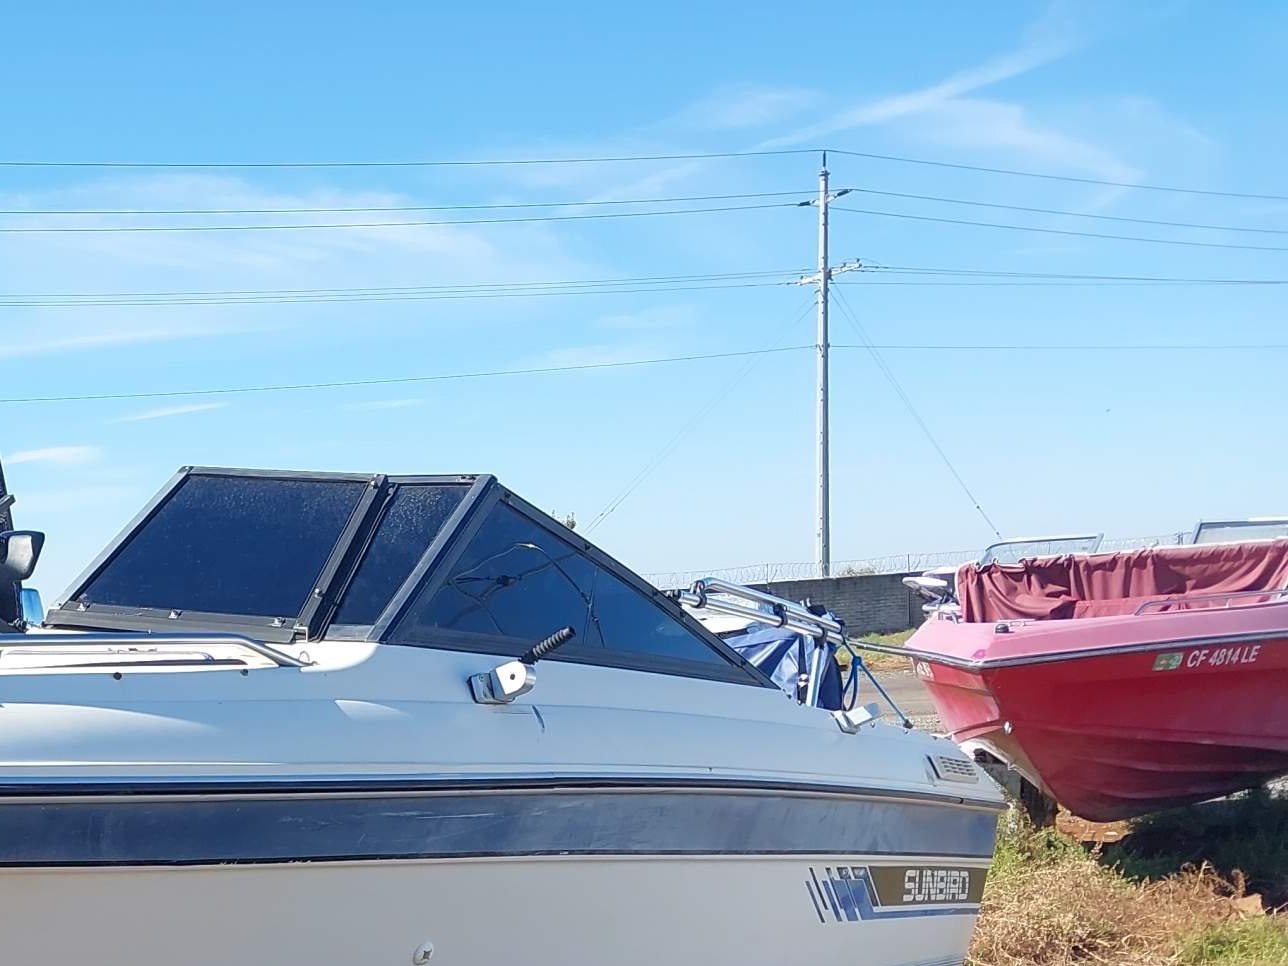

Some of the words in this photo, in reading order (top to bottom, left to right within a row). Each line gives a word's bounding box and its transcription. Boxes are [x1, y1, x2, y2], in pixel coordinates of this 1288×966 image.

[1187, 650, 1209, 668] CF
[1209, 647, 1241, 667] 4814
[1240, 645, 1261, 664] LE
[903, 869, 970, 902] SUNBIRD
